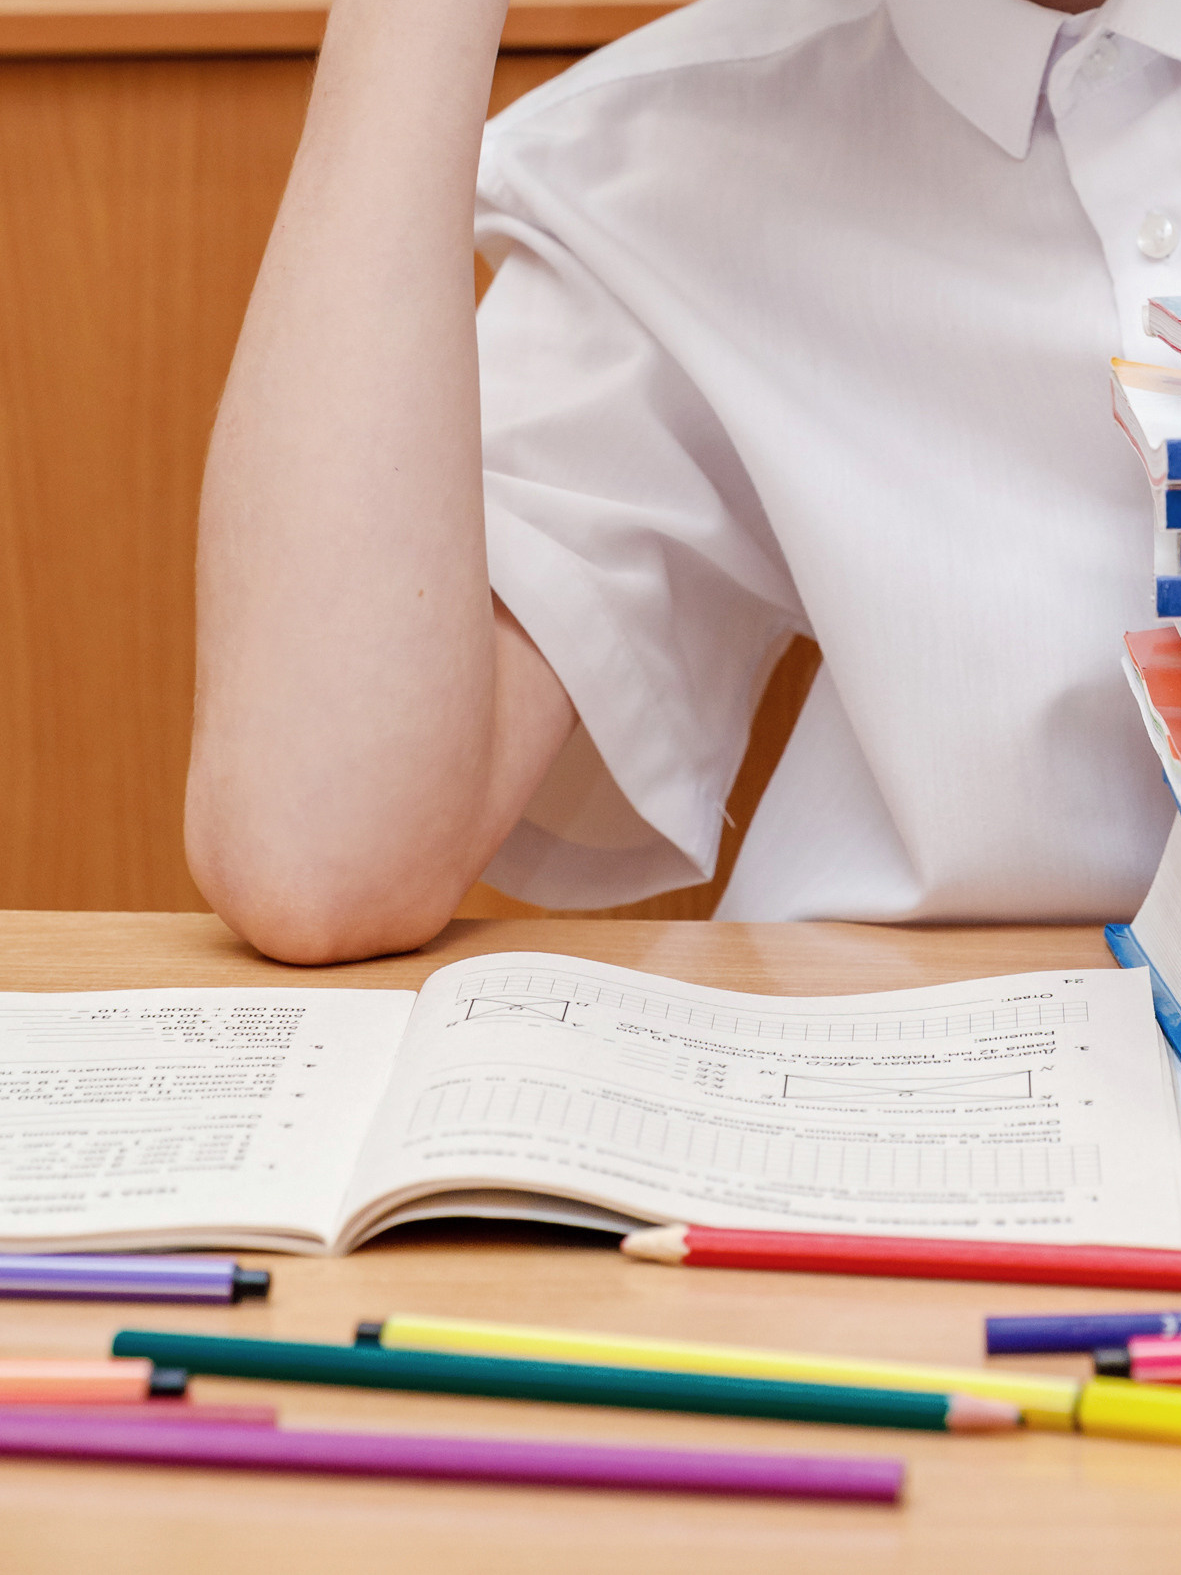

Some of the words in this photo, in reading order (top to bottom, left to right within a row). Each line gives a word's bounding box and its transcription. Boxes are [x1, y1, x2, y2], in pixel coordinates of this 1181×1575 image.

[1000, 993, 1052, 1002] Ответ:
[974, 1031, 1054, 1043] Решение:
[1005, 1041, 1055, 1051] равна
[683, 1043, 764, 1060] стороной
[962, 1046, 1056, 1062] Диагональ
[791, 1053, 874, 1061] периметр
[872, 1059, 951, 1067] квадрата
